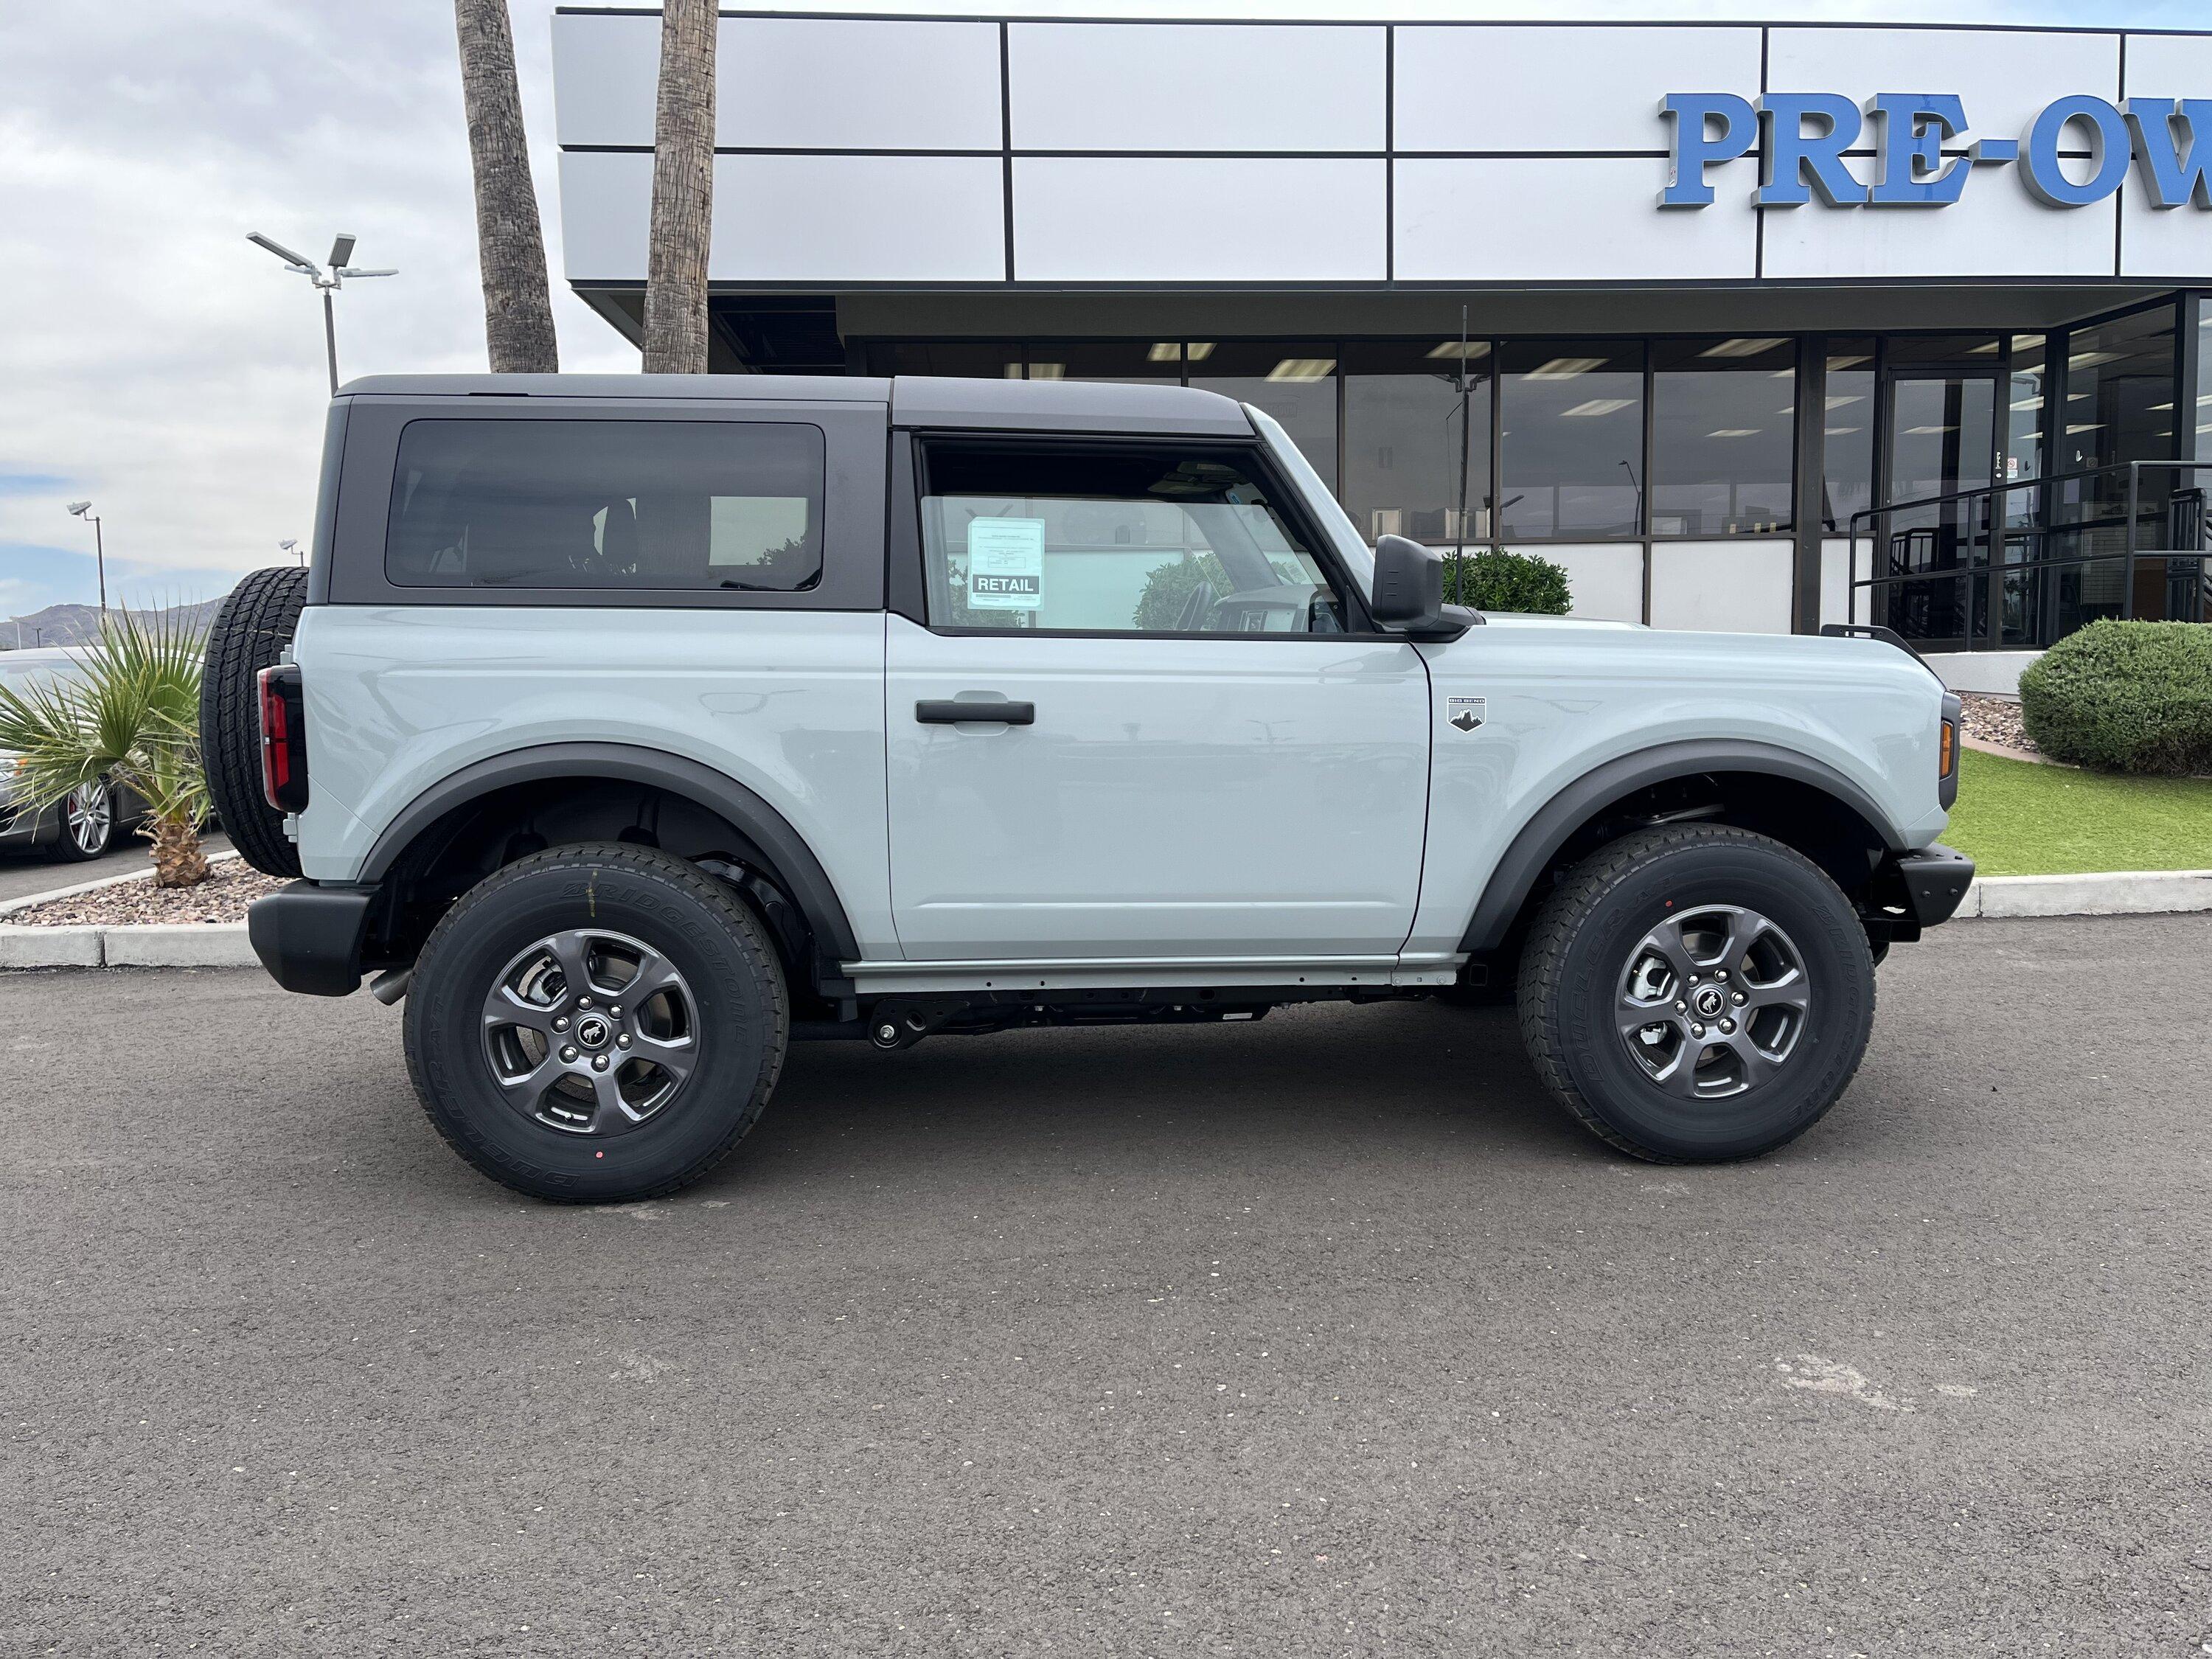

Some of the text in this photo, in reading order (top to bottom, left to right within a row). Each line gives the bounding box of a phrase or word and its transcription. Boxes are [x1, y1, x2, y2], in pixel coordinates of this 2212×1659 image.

[978, 577, 1034, 591] RETAIL
[560, 882, 751, 1048] BRIDGESTONE
[1787, 905, 1858, 1126] BRIDGESTONE
